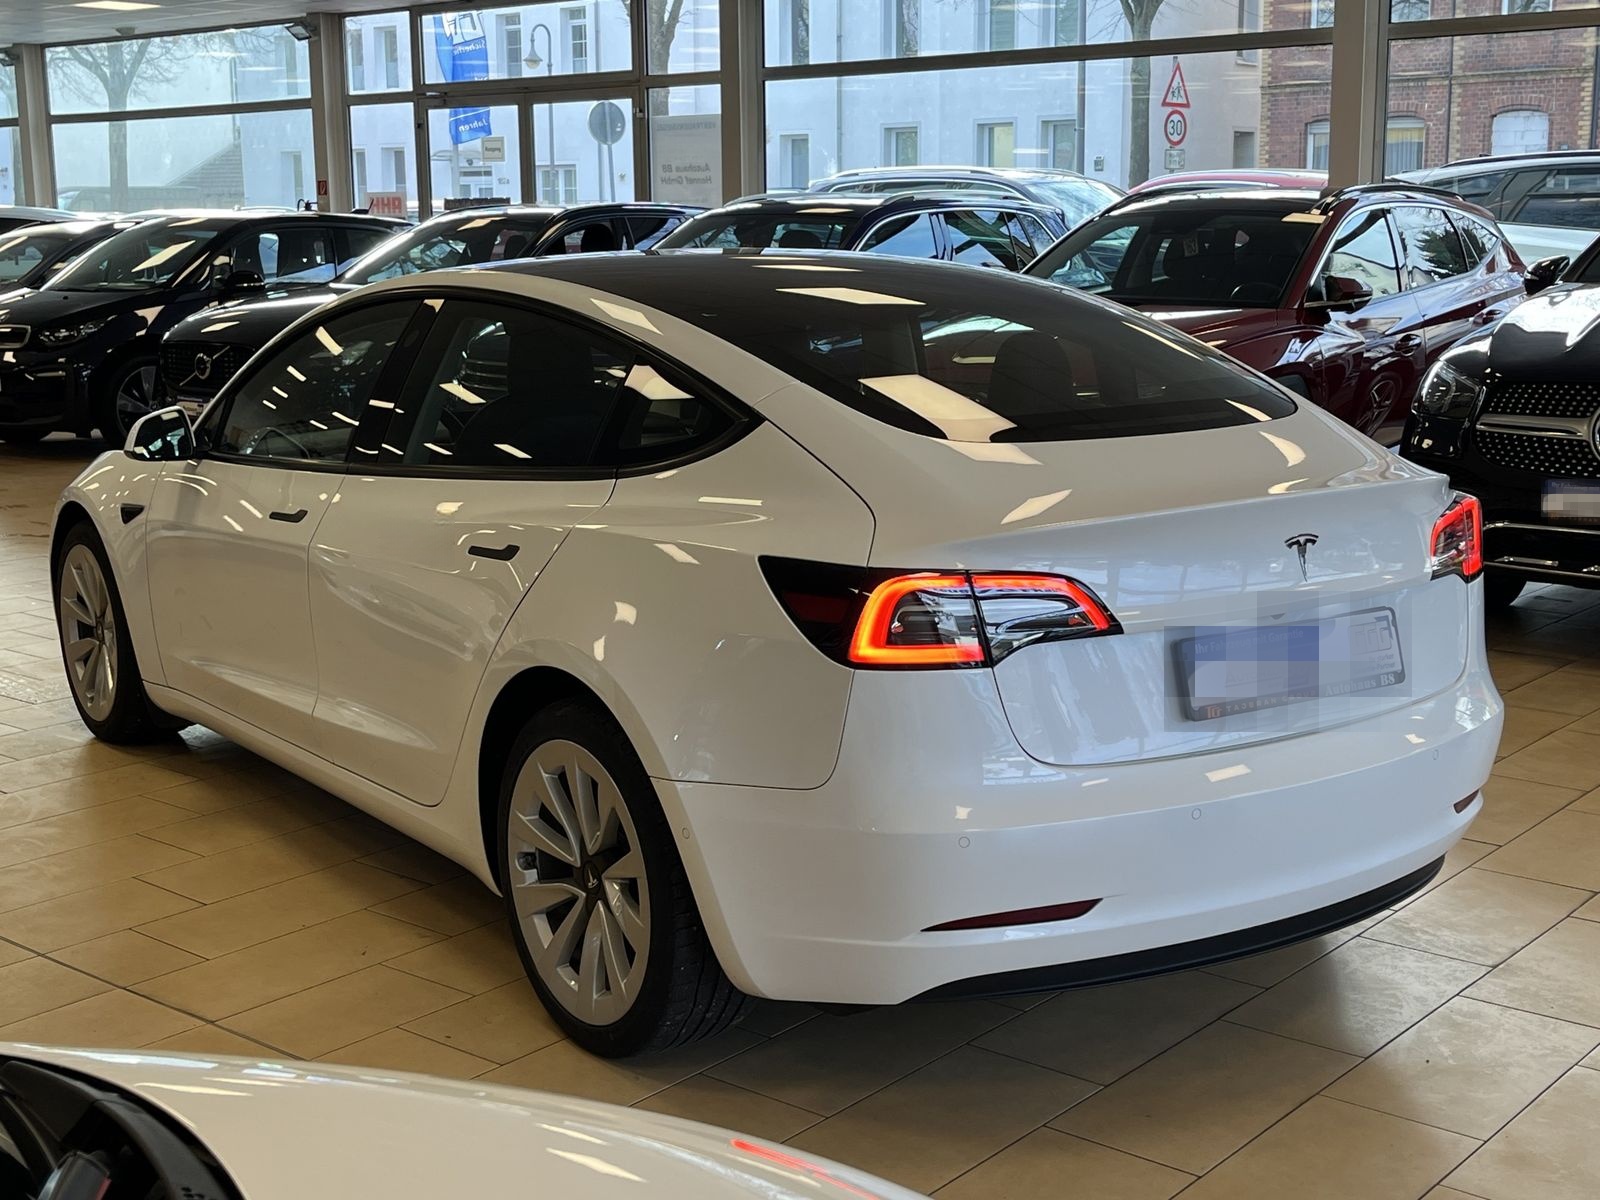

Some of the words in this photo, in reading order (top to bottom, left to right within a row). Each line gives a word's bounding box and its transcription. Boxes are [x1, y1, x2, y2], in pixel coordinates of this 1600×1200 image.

[1168, 119, 1183, 136] 30
[1194, 642, 1209, 655] Ihr
[1325, 679, 1377, 697] Autohaus
[1380, 673, 1395, 686] B8
